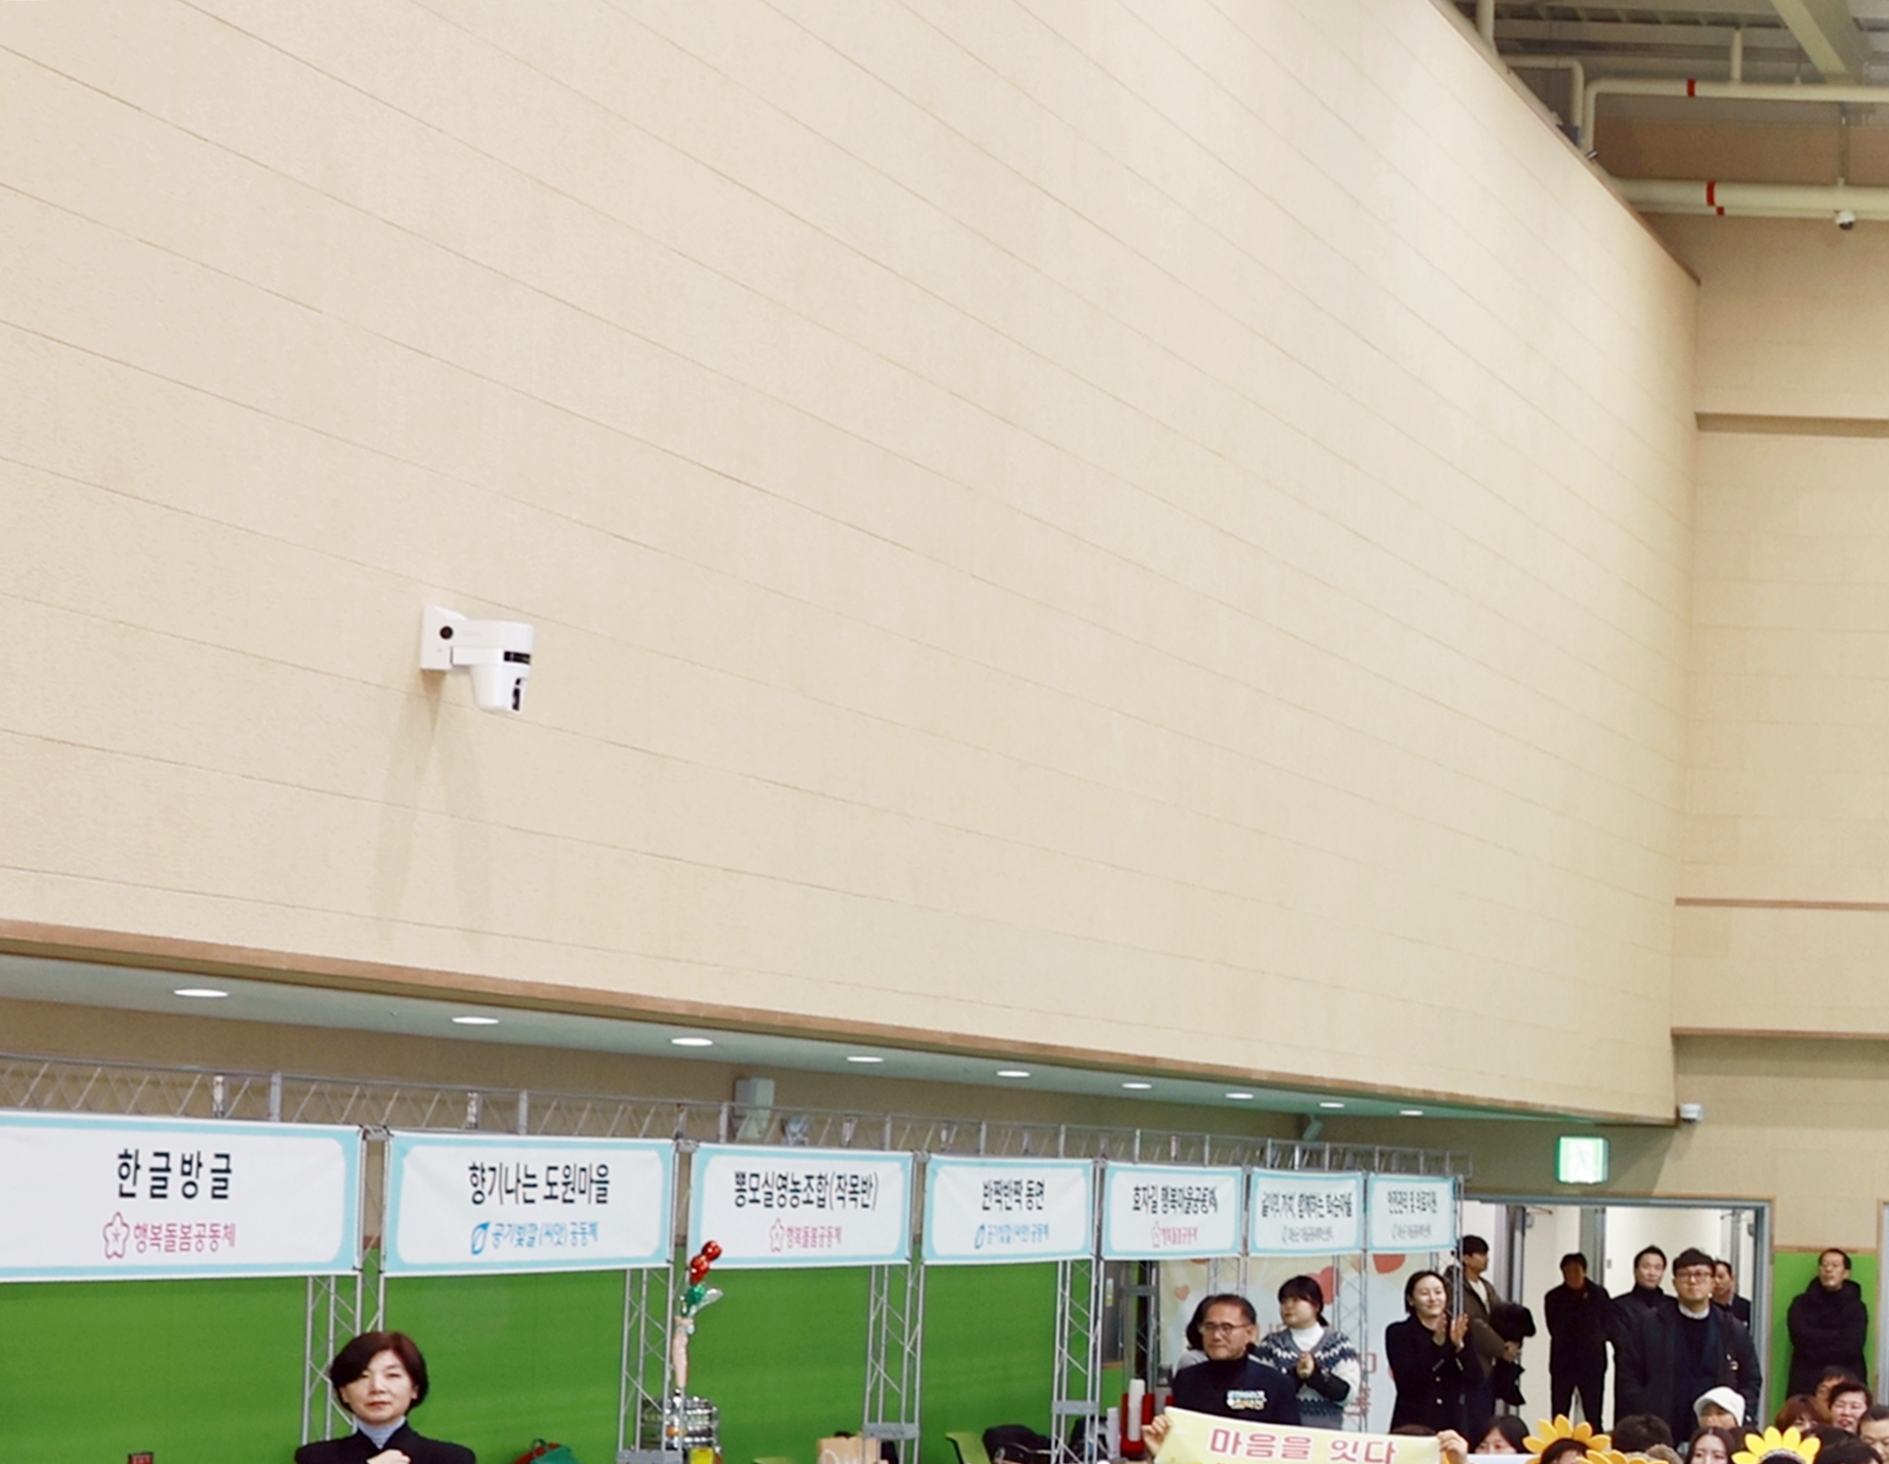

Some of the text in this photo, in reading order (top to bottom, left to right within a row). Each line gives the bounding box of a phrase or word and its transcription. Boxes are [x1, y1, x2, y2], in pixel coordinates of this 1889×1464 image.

[469, 1162, 610, 1204] 향기나는 도원마을
[1132, 1185, 1158, 1214] 효자길
[134, 1223, 235, 1254] 행복돌봄공동체
[570, 1222, 598, 1247] 공동체
[1210, 1428, 1312, 1460] 마음을
